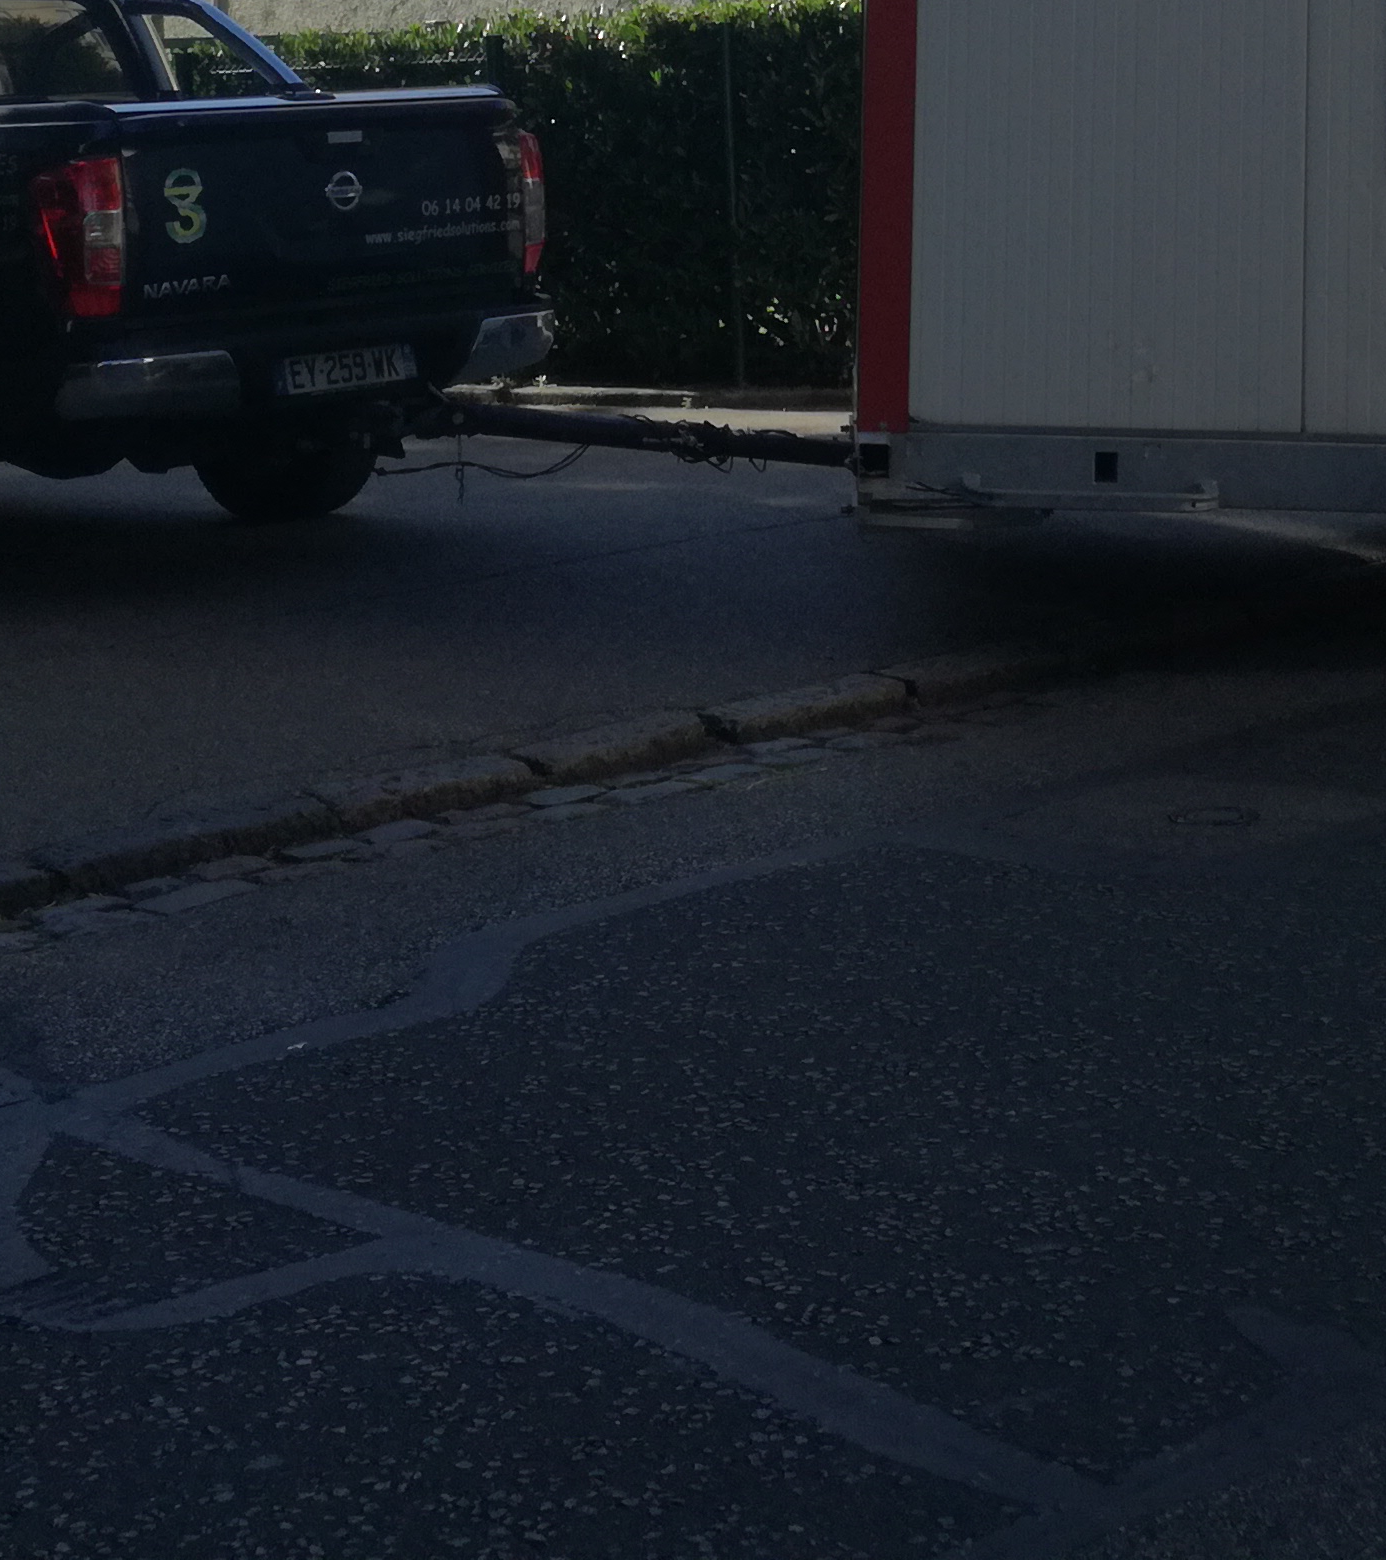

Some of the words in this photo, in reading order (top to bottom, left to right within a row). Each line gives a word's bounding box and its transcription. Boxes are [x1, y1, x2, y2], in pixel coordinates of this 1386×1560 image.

[420, 199, 440, 217] 06
[445, 198, 462, 215] 14
[464, 197, 482, 213] 04
[485, 194, 502, 211] 42
[506, 192, 522, 209] 19
[142, 273, 232, 300] NAVARA
